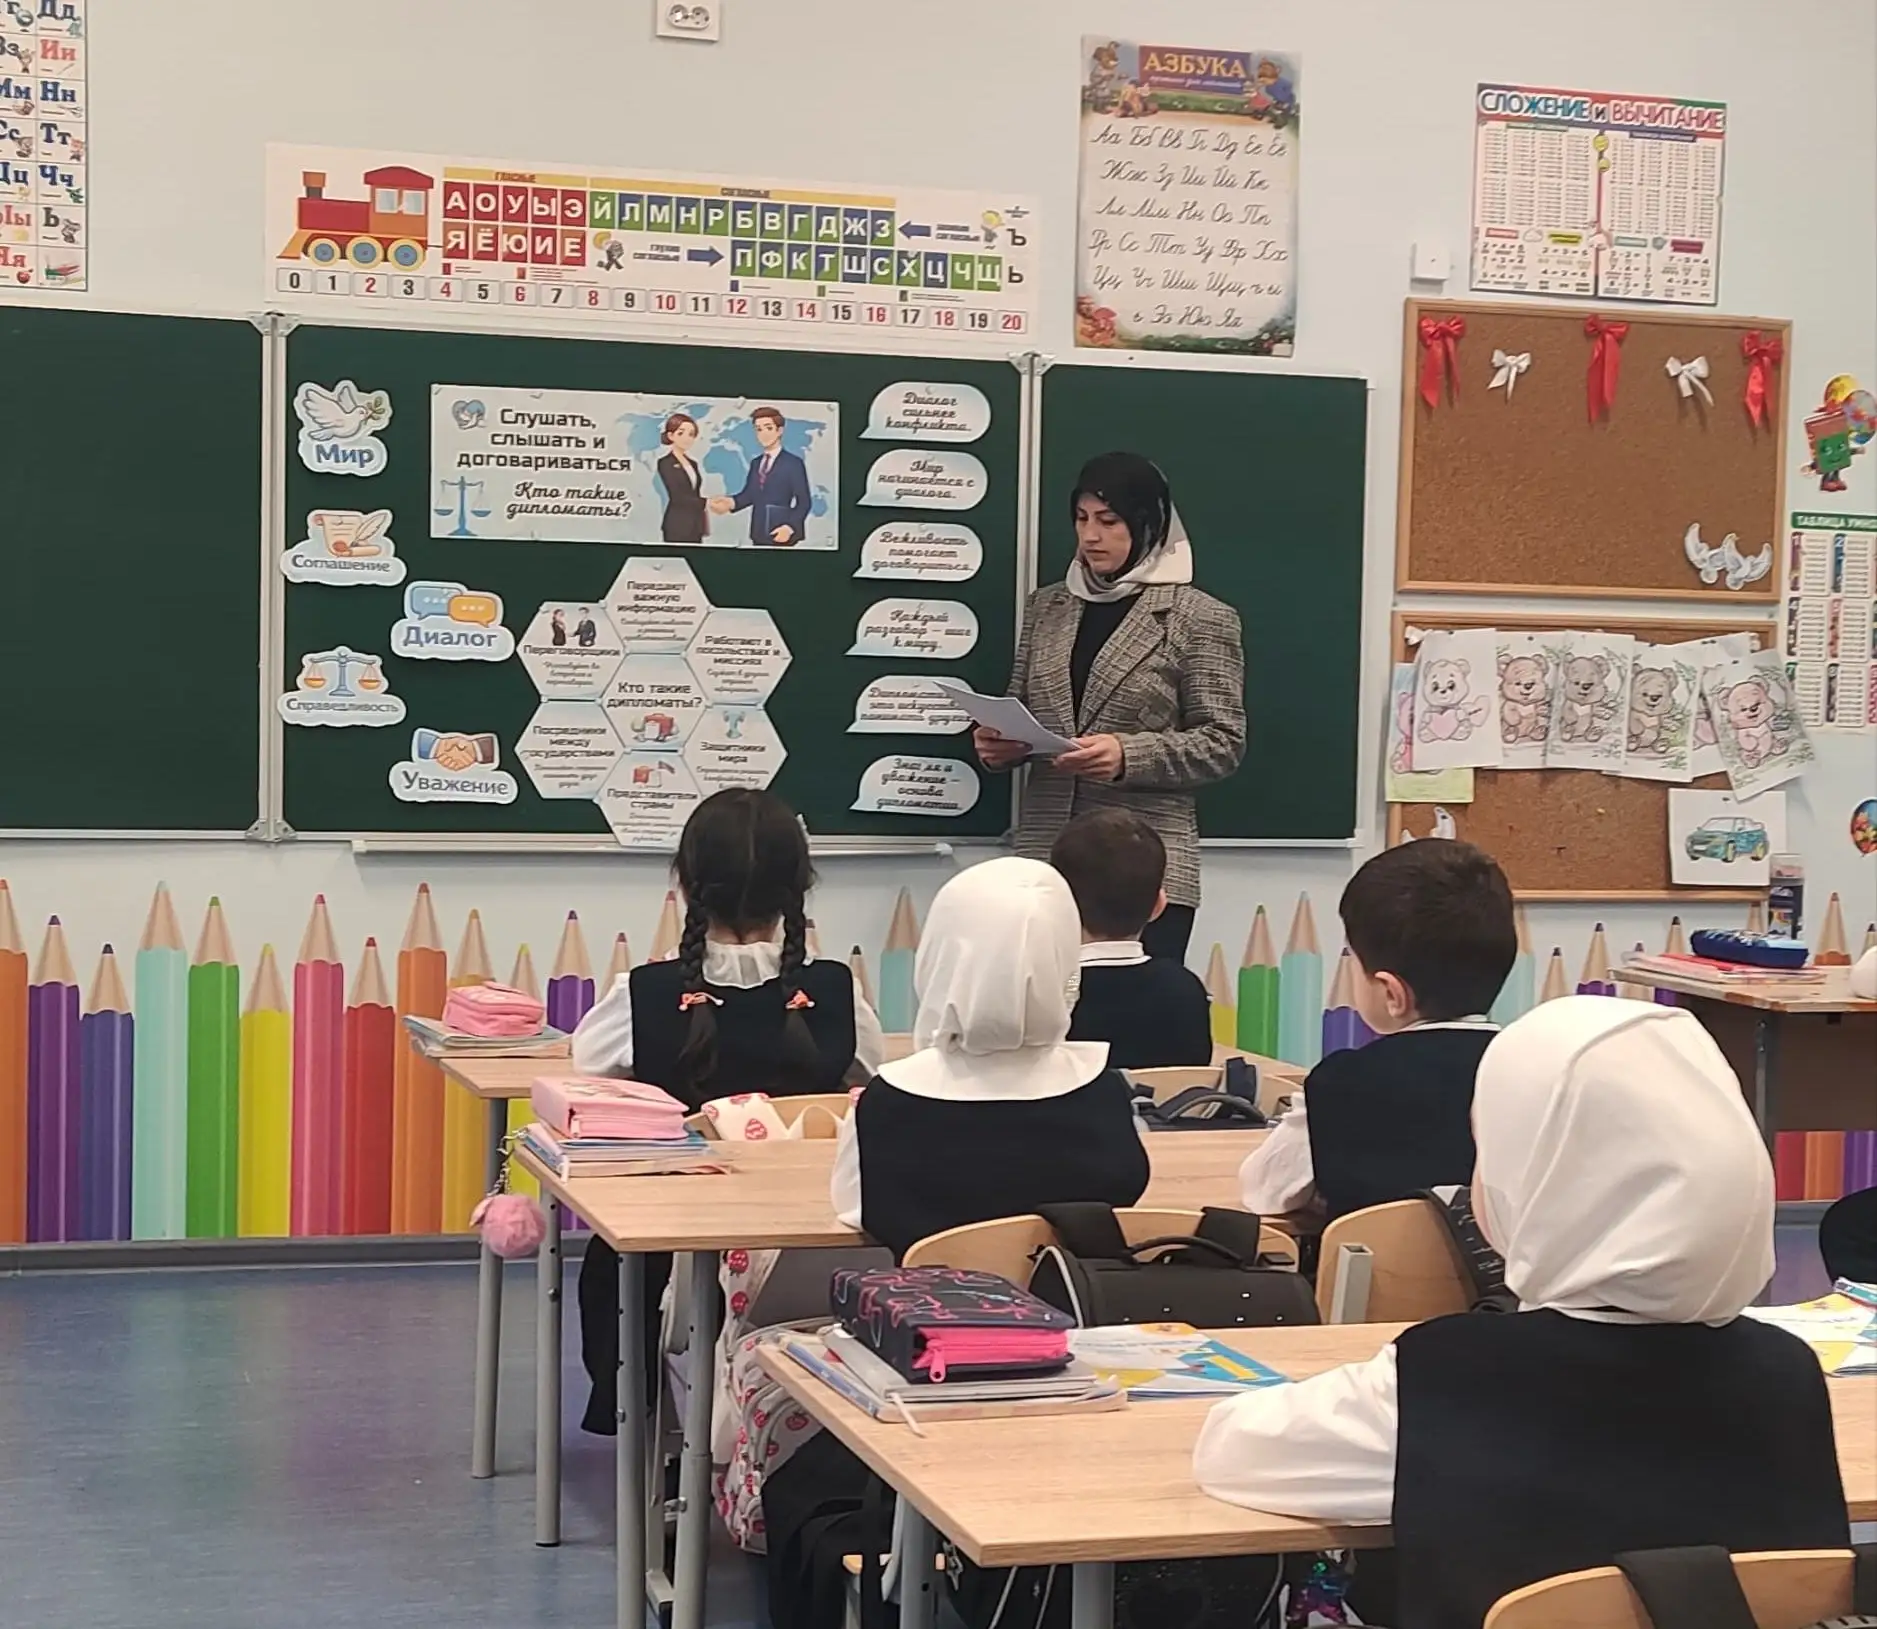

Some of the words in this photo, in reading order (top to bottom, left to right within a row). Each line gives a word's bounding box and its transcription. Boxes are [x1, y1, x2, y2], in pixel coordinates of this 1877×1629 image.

[1145, 53, 1246, 78] АЗБУКА
[40, 80, 76, 102] Нн
[1481, 91, 1589, 119] СЛОЖЕНИЕ
[1612, 103, 1723, 129] ВЫЧИТАНИЕ
[40, 123, 72, 145] Тт
[38, 165, 74, 188] Чч
[1007, 229, 1027, 247] Ъ
[1009, 265, 1024, 284] Ь
[288, 272, 301, 289] 0
[328, 275, 337, 290] 1
[365, 277, 377, 293] 2
[403, 280, 414, 296] 3
[440, 282, 452, 298] 4
[477, 283, 489, 300] 5
[515, 286, 526, 302] 6
[551, 288, 563, 304] 7
[588, 290, 599, 306] 8
[624, 291, 635, 308] 9
[657, 294, 676, 311] 10
[692, 296, 710, 312] 11
[727, 298, 747, 315] 12
[762, 300, 782, 316] 13
[797, 302, 817, 319] 14
[833, 304, 851, 321] 15
[867, 305, 886, 323] 16
[901, 307, 921, 324] 17
[935, 309, 954, 326] 18
[969, 312, 988, 328] 19
[1002, 314, 1022, 330] 20
[903, 392, 958, 405] Диалог
[501, 409, 596, 429] Слушать,
[491, 433, 586, 448] слышать
[593, 438, 605, 448] и
[316, 445, 374, 468] Мир
[457, 453, 631, 471] договариваться
[515, 482, 561, 498] Кто
[565, 484, 626, 500] такие
[507, 502, 631, 519] дипломаты?
[292, 555, 390, 572] Соглашение
[403, 626, 497, 647] Диалог
[618, 682, 644, 693] Кто
[607, 698, 702, 708] дипломаты?
[402, 771, 508, 795] Уважение
